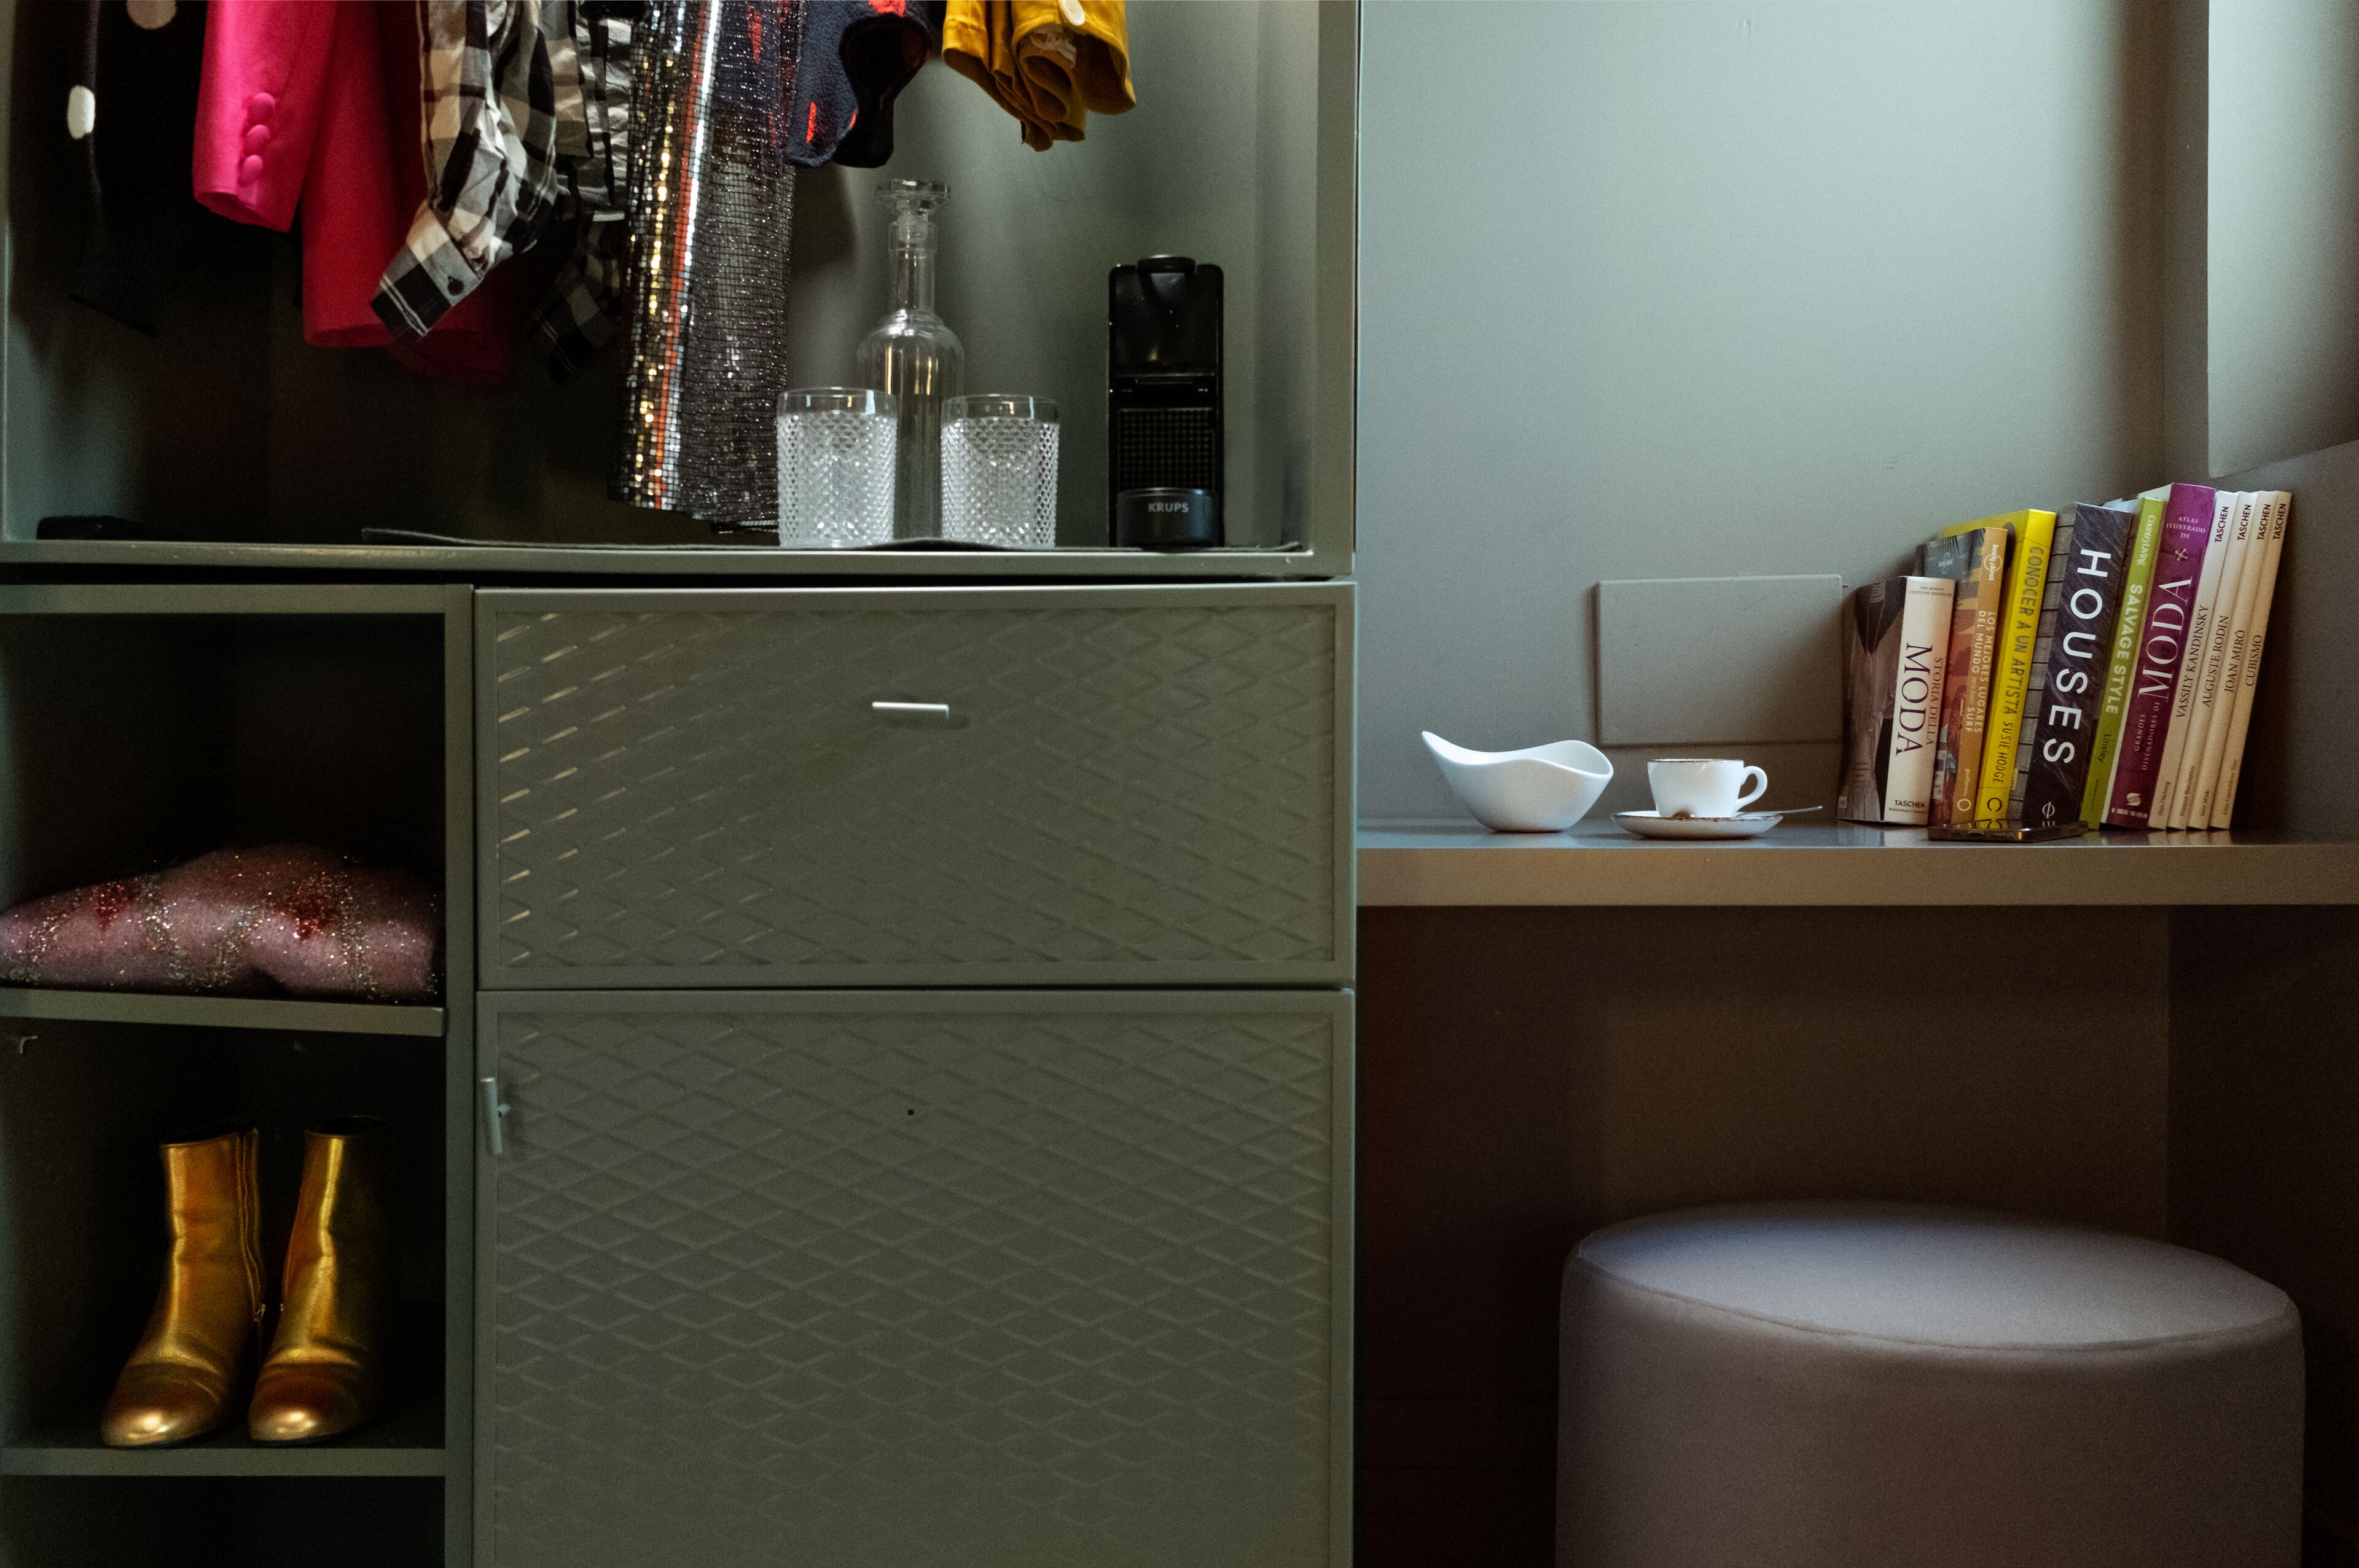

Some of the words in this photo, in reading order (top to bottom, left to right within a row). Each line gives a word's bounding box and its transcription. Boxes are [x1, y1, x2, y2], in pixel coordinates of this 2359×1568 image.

[1148, 502, 1189, 513] KRUPS
[2215, 506, 2229, 542] TASCHEN
[2237, 504, 2251, 540] TASCHEN
[2257, 504, 2271, 540] TASCHEN
[2273, 504, 2287, 540] TASCHEN
[2166, 523, 2206, 533] ILUSTRADO
[1989, 544, 1999, 563] lonely
[2019, 546, 2044, 617] CONOCER
[1977, 610, 1987, 628] DEL
[1986, 612, 1996, 631] LOS
[2016, 620, 2031, 630] A
[2116, 583, 2143, 660] SALVAGE
[1971, 633, 1984, 674] MUNDO
[2014, 635, 2030, 653] UN
[2043, 548, 2111, 764] HOUSES
[2137, 575, 2193, 703] MODA
[1980, 636, 1993, 682] MEJORES
[2176, 675, 2193, 718] VASSILY
[2186, 605, 2208, 673] KANDINSKY
[2202, 655, 2221, 707] AUGUSTE
[2212, 615, 2229, 652] RODIN
[2224, 664, 2239, 693] JOAN
[2232, 630, 2245, 661] MIRÓ
[2245, 634, 2262, 686] CUBISMO
[1930, 657, 1943, 702] STORIA
[2002, 658, 2025, 715] ARTISTA
[2105, 664, 2127, 714] STYLE
[1895, 642, 1933, 756] MODA
[1974, 686, 1987, 733] LUGARES
[1926, 707, 1938, 745] DELLA
[1965, 707, 1975, 733] SURF
[1998, 721, 2013, 751] SUSIE
[2134, 714, 2146, 751] GRANDES
[2098, 733, 2112, 763] Linsley
[1992, 752, 2008, 784] HODGE
